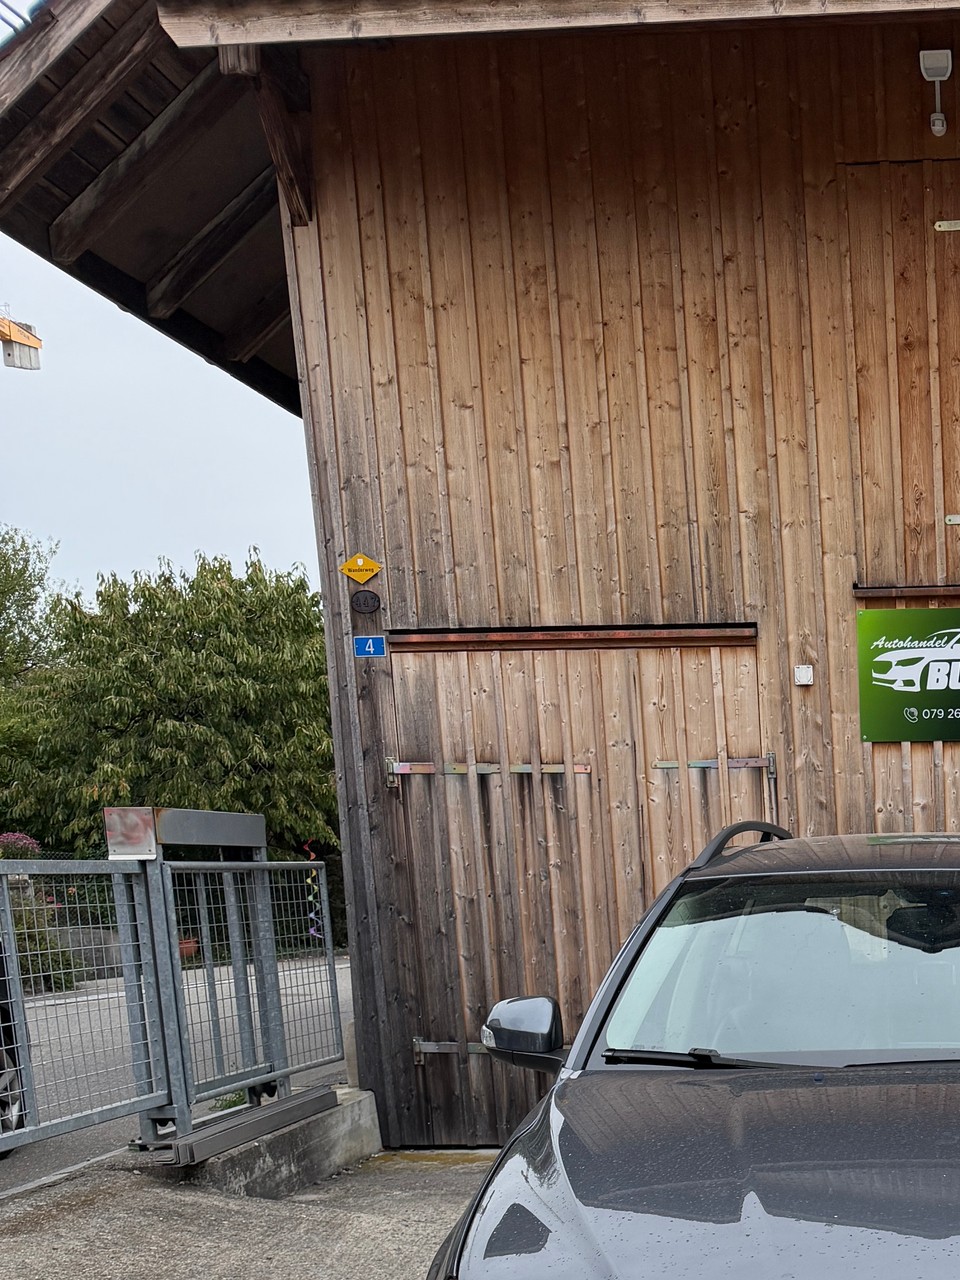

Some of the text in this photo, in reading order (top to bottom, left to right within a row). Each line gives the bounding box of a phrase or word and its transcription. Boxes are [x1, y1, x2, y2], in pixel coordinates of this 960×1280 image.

[365, 638, 375, 654] 4
[870, 636, 949, 649] Autohandel
[922, 709, 944, 719] 079
